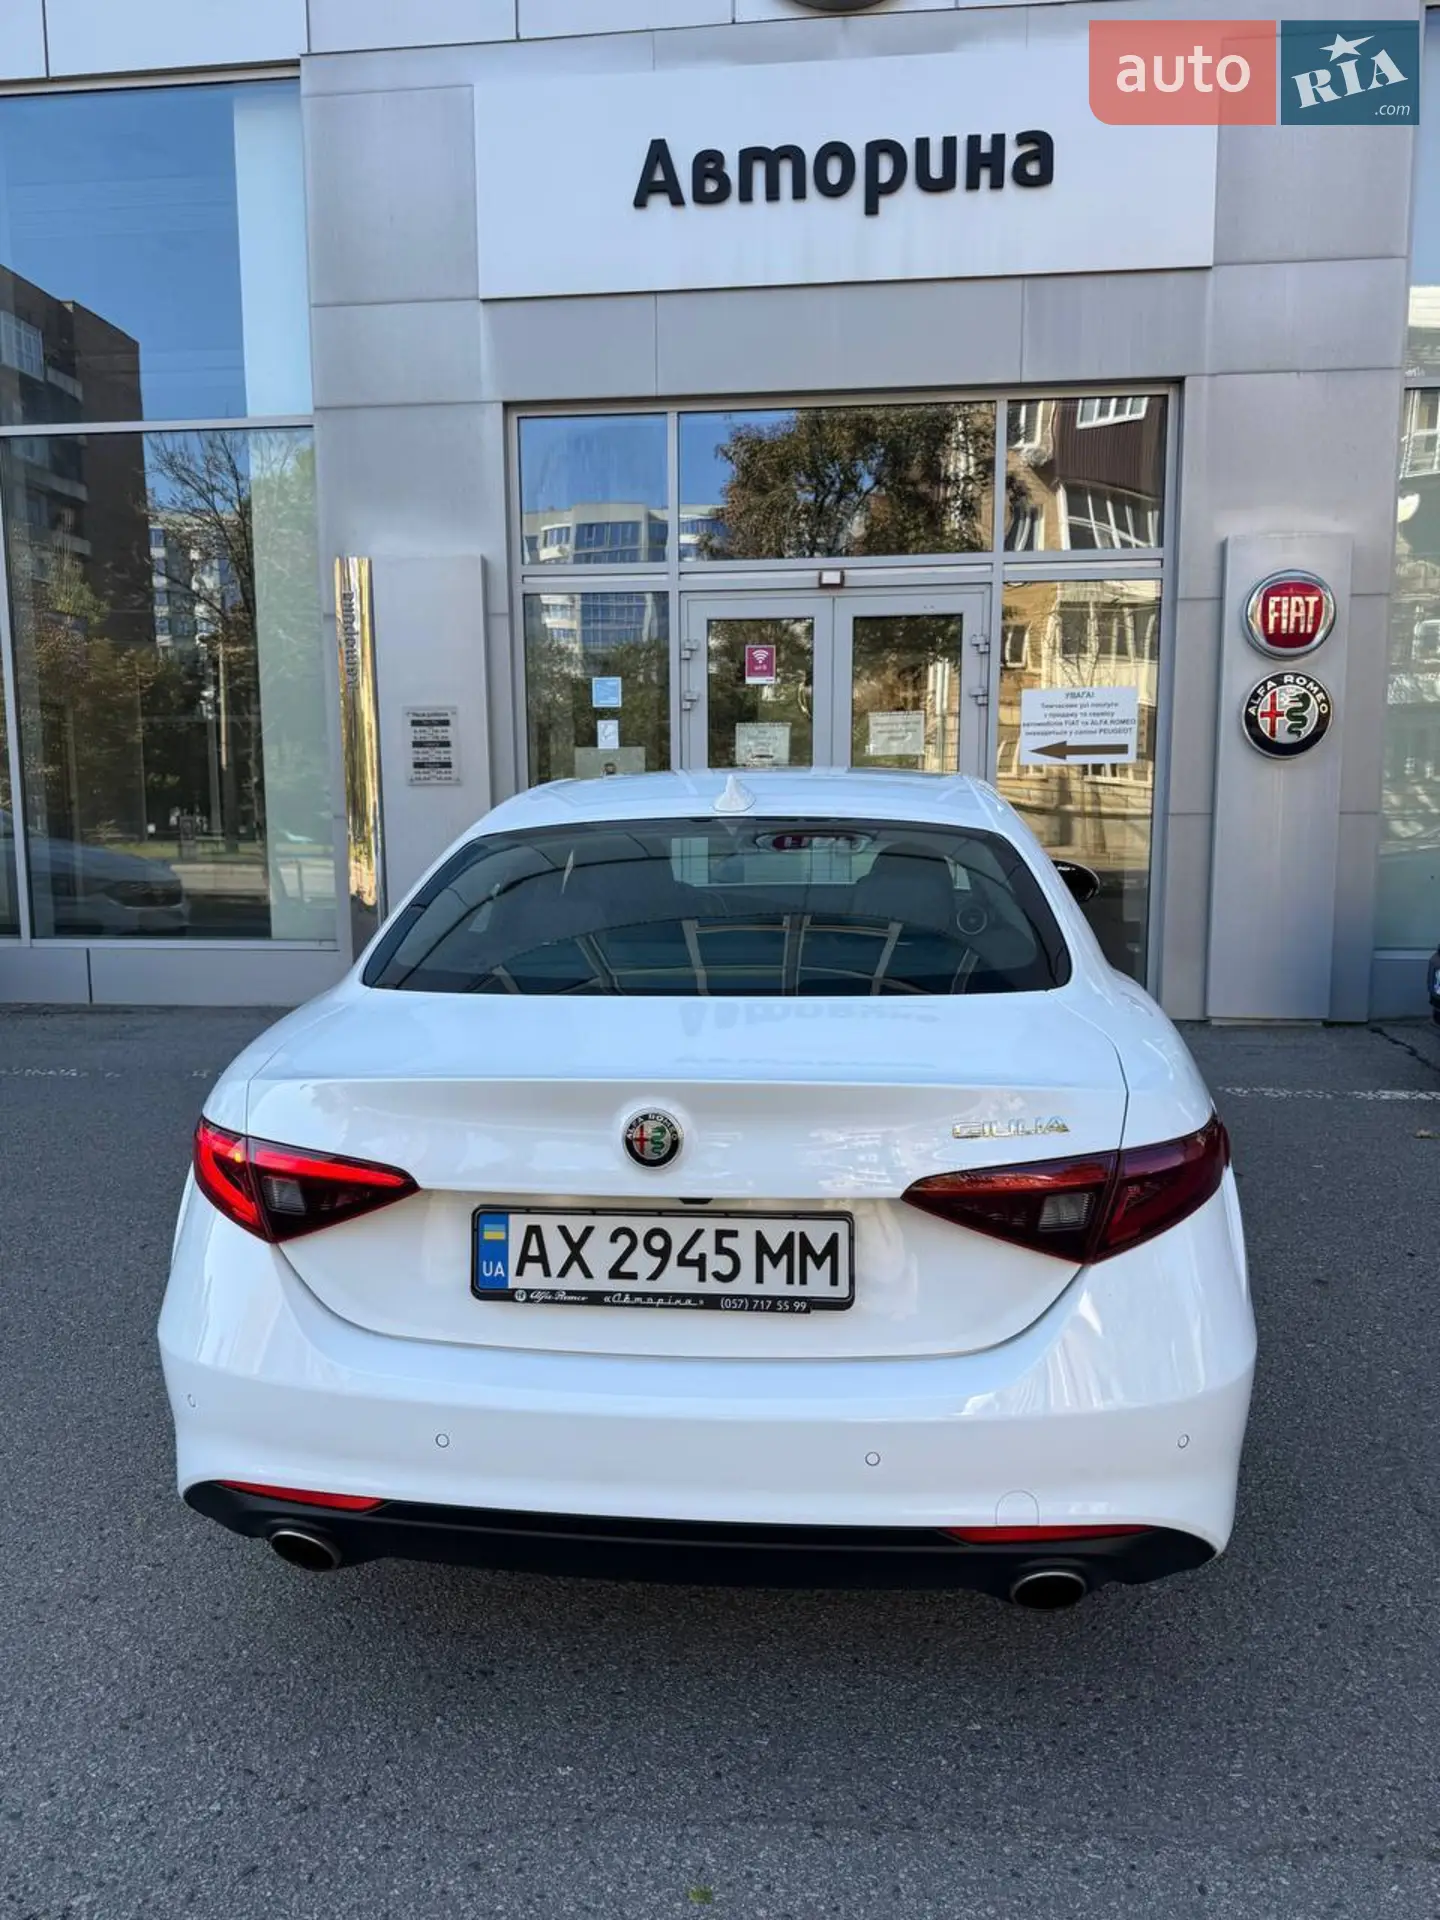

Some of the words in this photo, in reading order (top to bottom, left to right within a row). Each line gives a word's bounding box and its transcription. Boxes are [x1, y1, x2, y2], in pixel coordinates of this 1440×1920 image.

[633, 129, 1055, 216] Авторина
[1268, 596, 1319, 634] FIAT
[1247, 680, 1278, 716] ALFA
[1283, 674, 1329, 714] ROMEO
[482, 1261, 506, 1277] UA
[514, 1224, 596, 1279] AX
[607, 1226, 741, 1283] 2945
[755, 1230, 840, 1287] MM
[720, 1297, 749, 1310] (057)
[752, 1300, 772, 1311] 717
[776, 1300, 790, 1311] 55
[793, 1301, 807, 1312] 99
